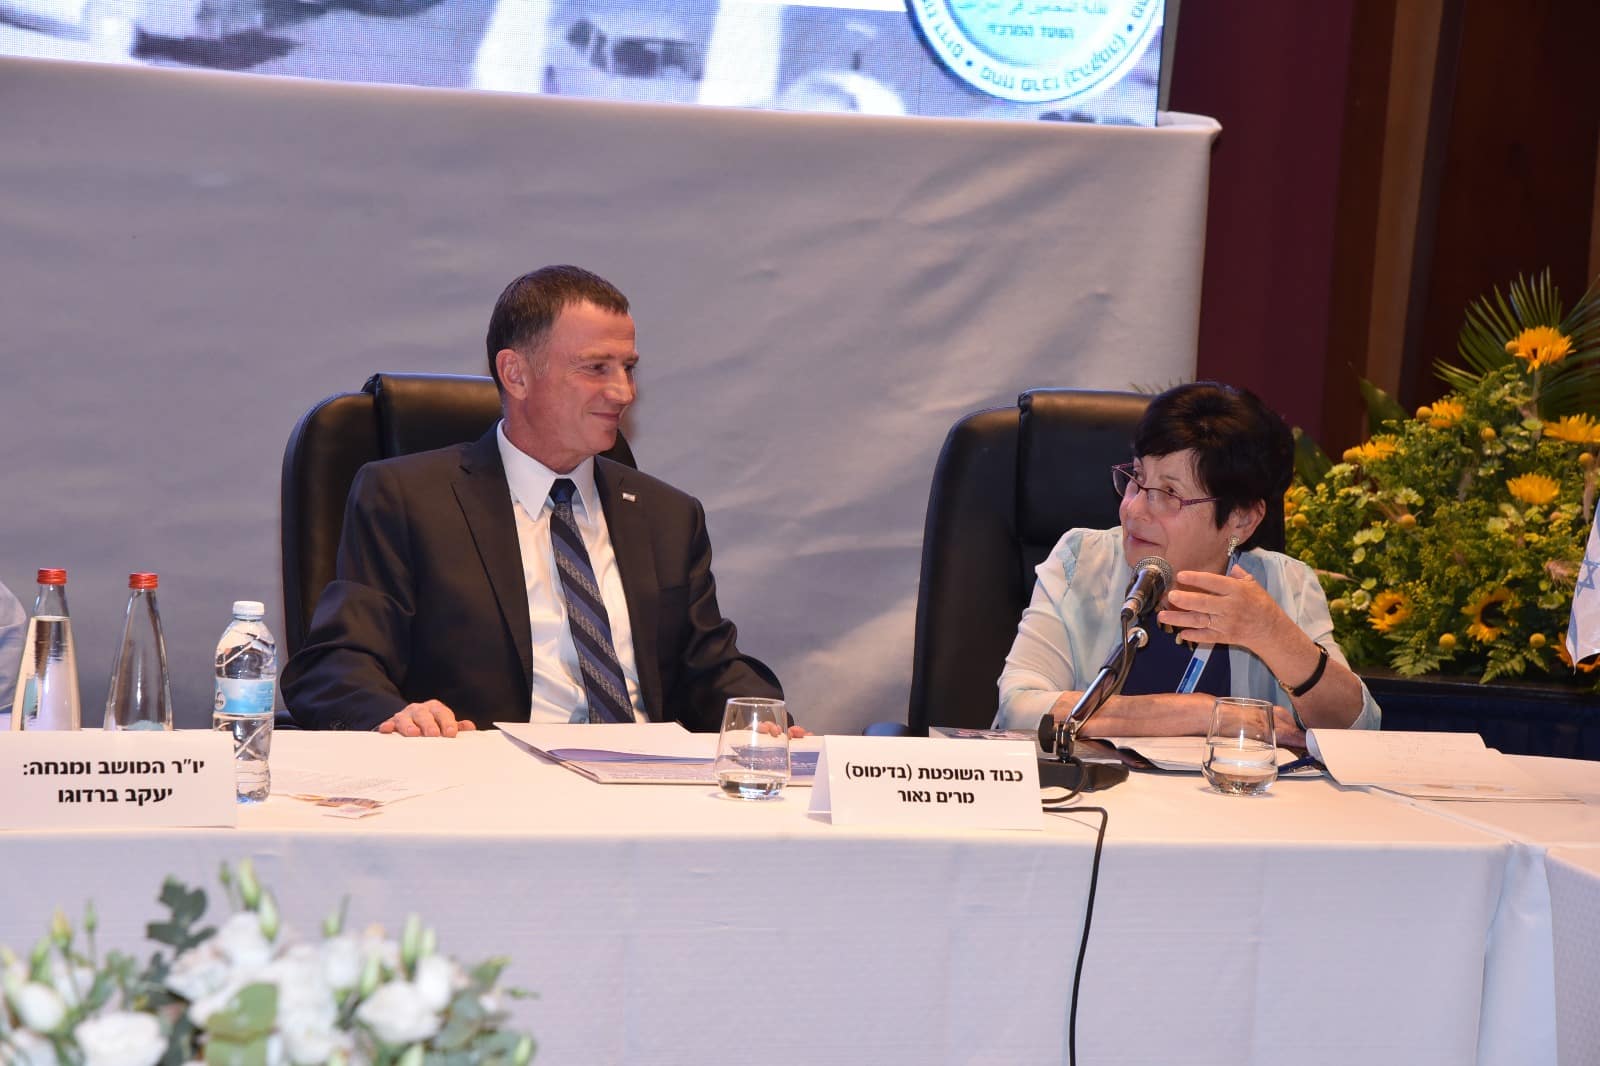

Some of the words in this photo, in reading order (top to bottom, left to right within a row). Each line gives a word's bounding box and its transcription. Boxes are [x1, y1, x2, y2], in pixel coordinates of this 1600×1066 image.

[23, 761, 92, 776] ומנחה:
[97, 760, 167, 775] המושב
[845, 761, 913, 782] (בדימוס)
[917, 767, 985, 781] השופטת
[989, 769, 1024, 783] כבוד
[57, 788, 119, 804] ברדוגו
[124, 787, 173, 807] יעקב
[897, 789, 932, 803] נאור
[935, 791, 975, 804] מרים
